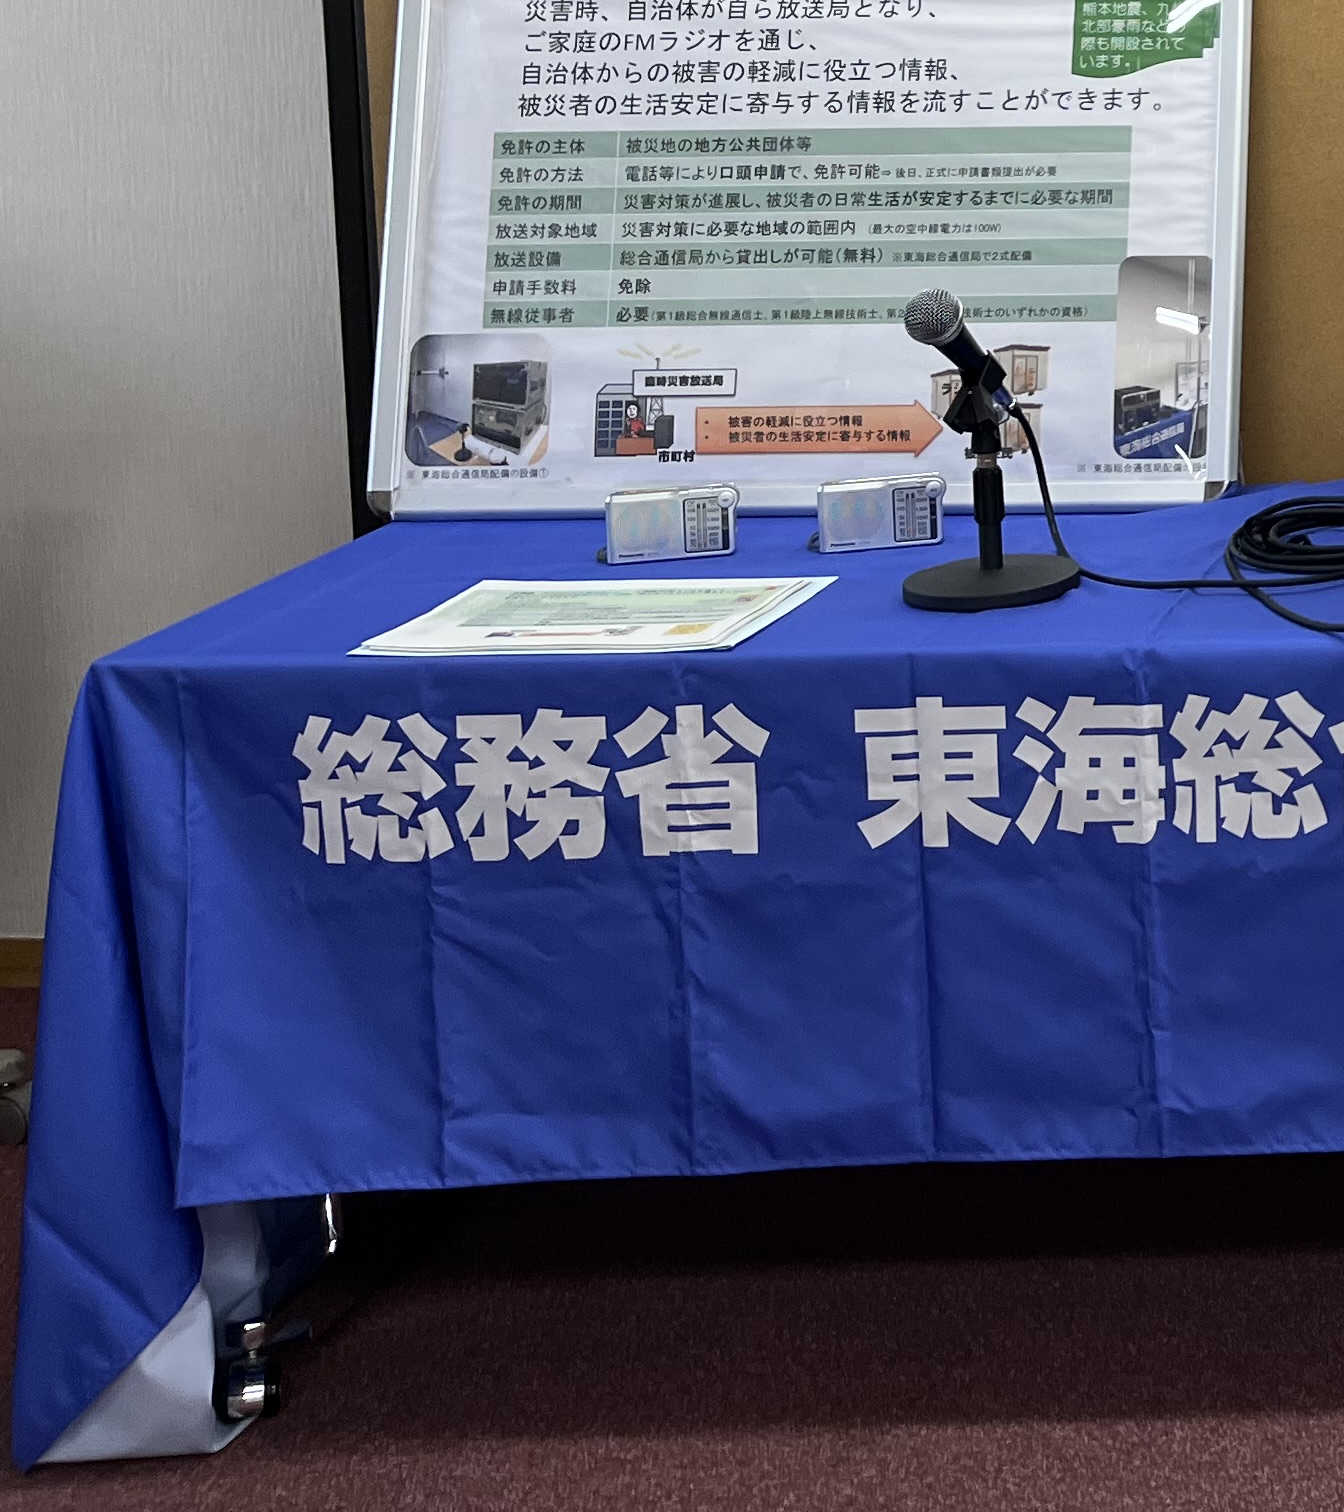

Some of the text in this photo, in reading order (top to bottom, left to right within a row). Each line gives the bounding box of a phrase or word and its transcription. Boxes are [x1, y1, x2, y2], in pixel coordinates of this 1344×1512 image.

[1082, 2, 1187, 17] 熊本地震、九
[524, 27, 818, 54] ご家庭のFMラジオを通じ、
[1080, 36, 1186, 52] 際も開設されて
[521, 56, 960, 86] 自治体からの被害の軽減に役立つ情報、
[1078, 55, 1131, 70] います。
[516, 86, 1163, 117] 被災者の生活安定に寄与する情報を流すことができます。
[500, 138, 586, 156] 免許の主体
[626, 135, 812, 154] 被災地の地方公共団体等
[498, 166, 585, 184] 免許の方法
[624, 163, 881, 183] 電話等により口頭申請で、免許可能
[497, 194, 583, 212] 免許の期間
[623, 188, 1113, 211] 災害対策が進展し、被災者の日常生活が安定するまでに必要な期間
[495, 223, 598, 240] 放送対象地域
[621, 219, 856, 238] 災害対策に必要な地域の範囲内
[493, 250, 562, 268] 放送設備
[619, 246, 883, 267] 総合通信局から貸出しが可能(無料)
[492, 278, 577, 297] 申請手数料
[617, 277, 652, 296] 免除
[490, 307, 575, 325] 無線従事者
[644, 374, 724, 388] 臨時災害放送局
[728, 414, 863, 428] 被害の軽減に役立つ情報
[728, 429, 912, 444] 被災者の生活安定に寄与する情報
[657, 449, 696, 463] 市町村
[288, 702, 772, 865] 総務省
